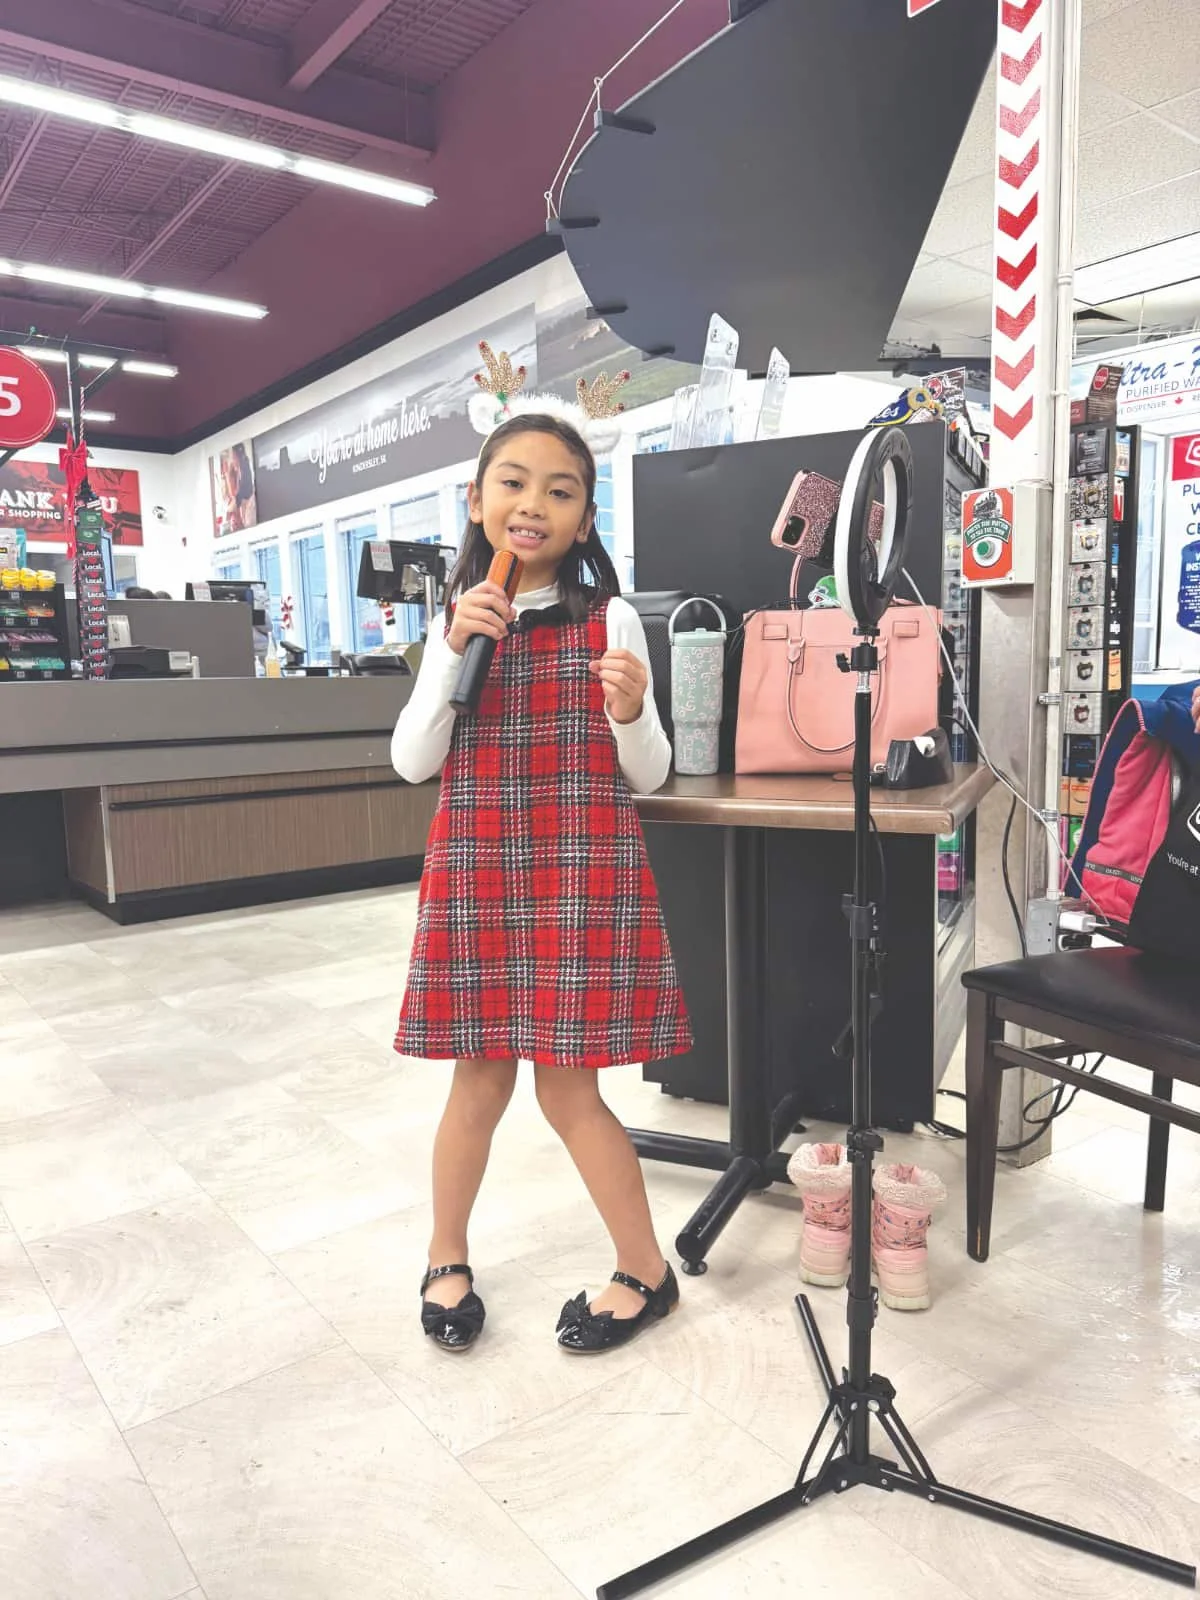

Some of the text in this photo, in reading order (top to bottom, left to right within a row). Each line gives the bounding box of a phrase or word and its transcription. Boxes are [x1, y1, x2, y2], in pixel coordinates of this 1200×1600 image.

[1120, 360, 1168, 386] ltra
[1126, 380, 1179, 399] PURIFIED
[308, 398, 431, 485] You're at home here.
[8, 508, 62, 520] SHOPPING
